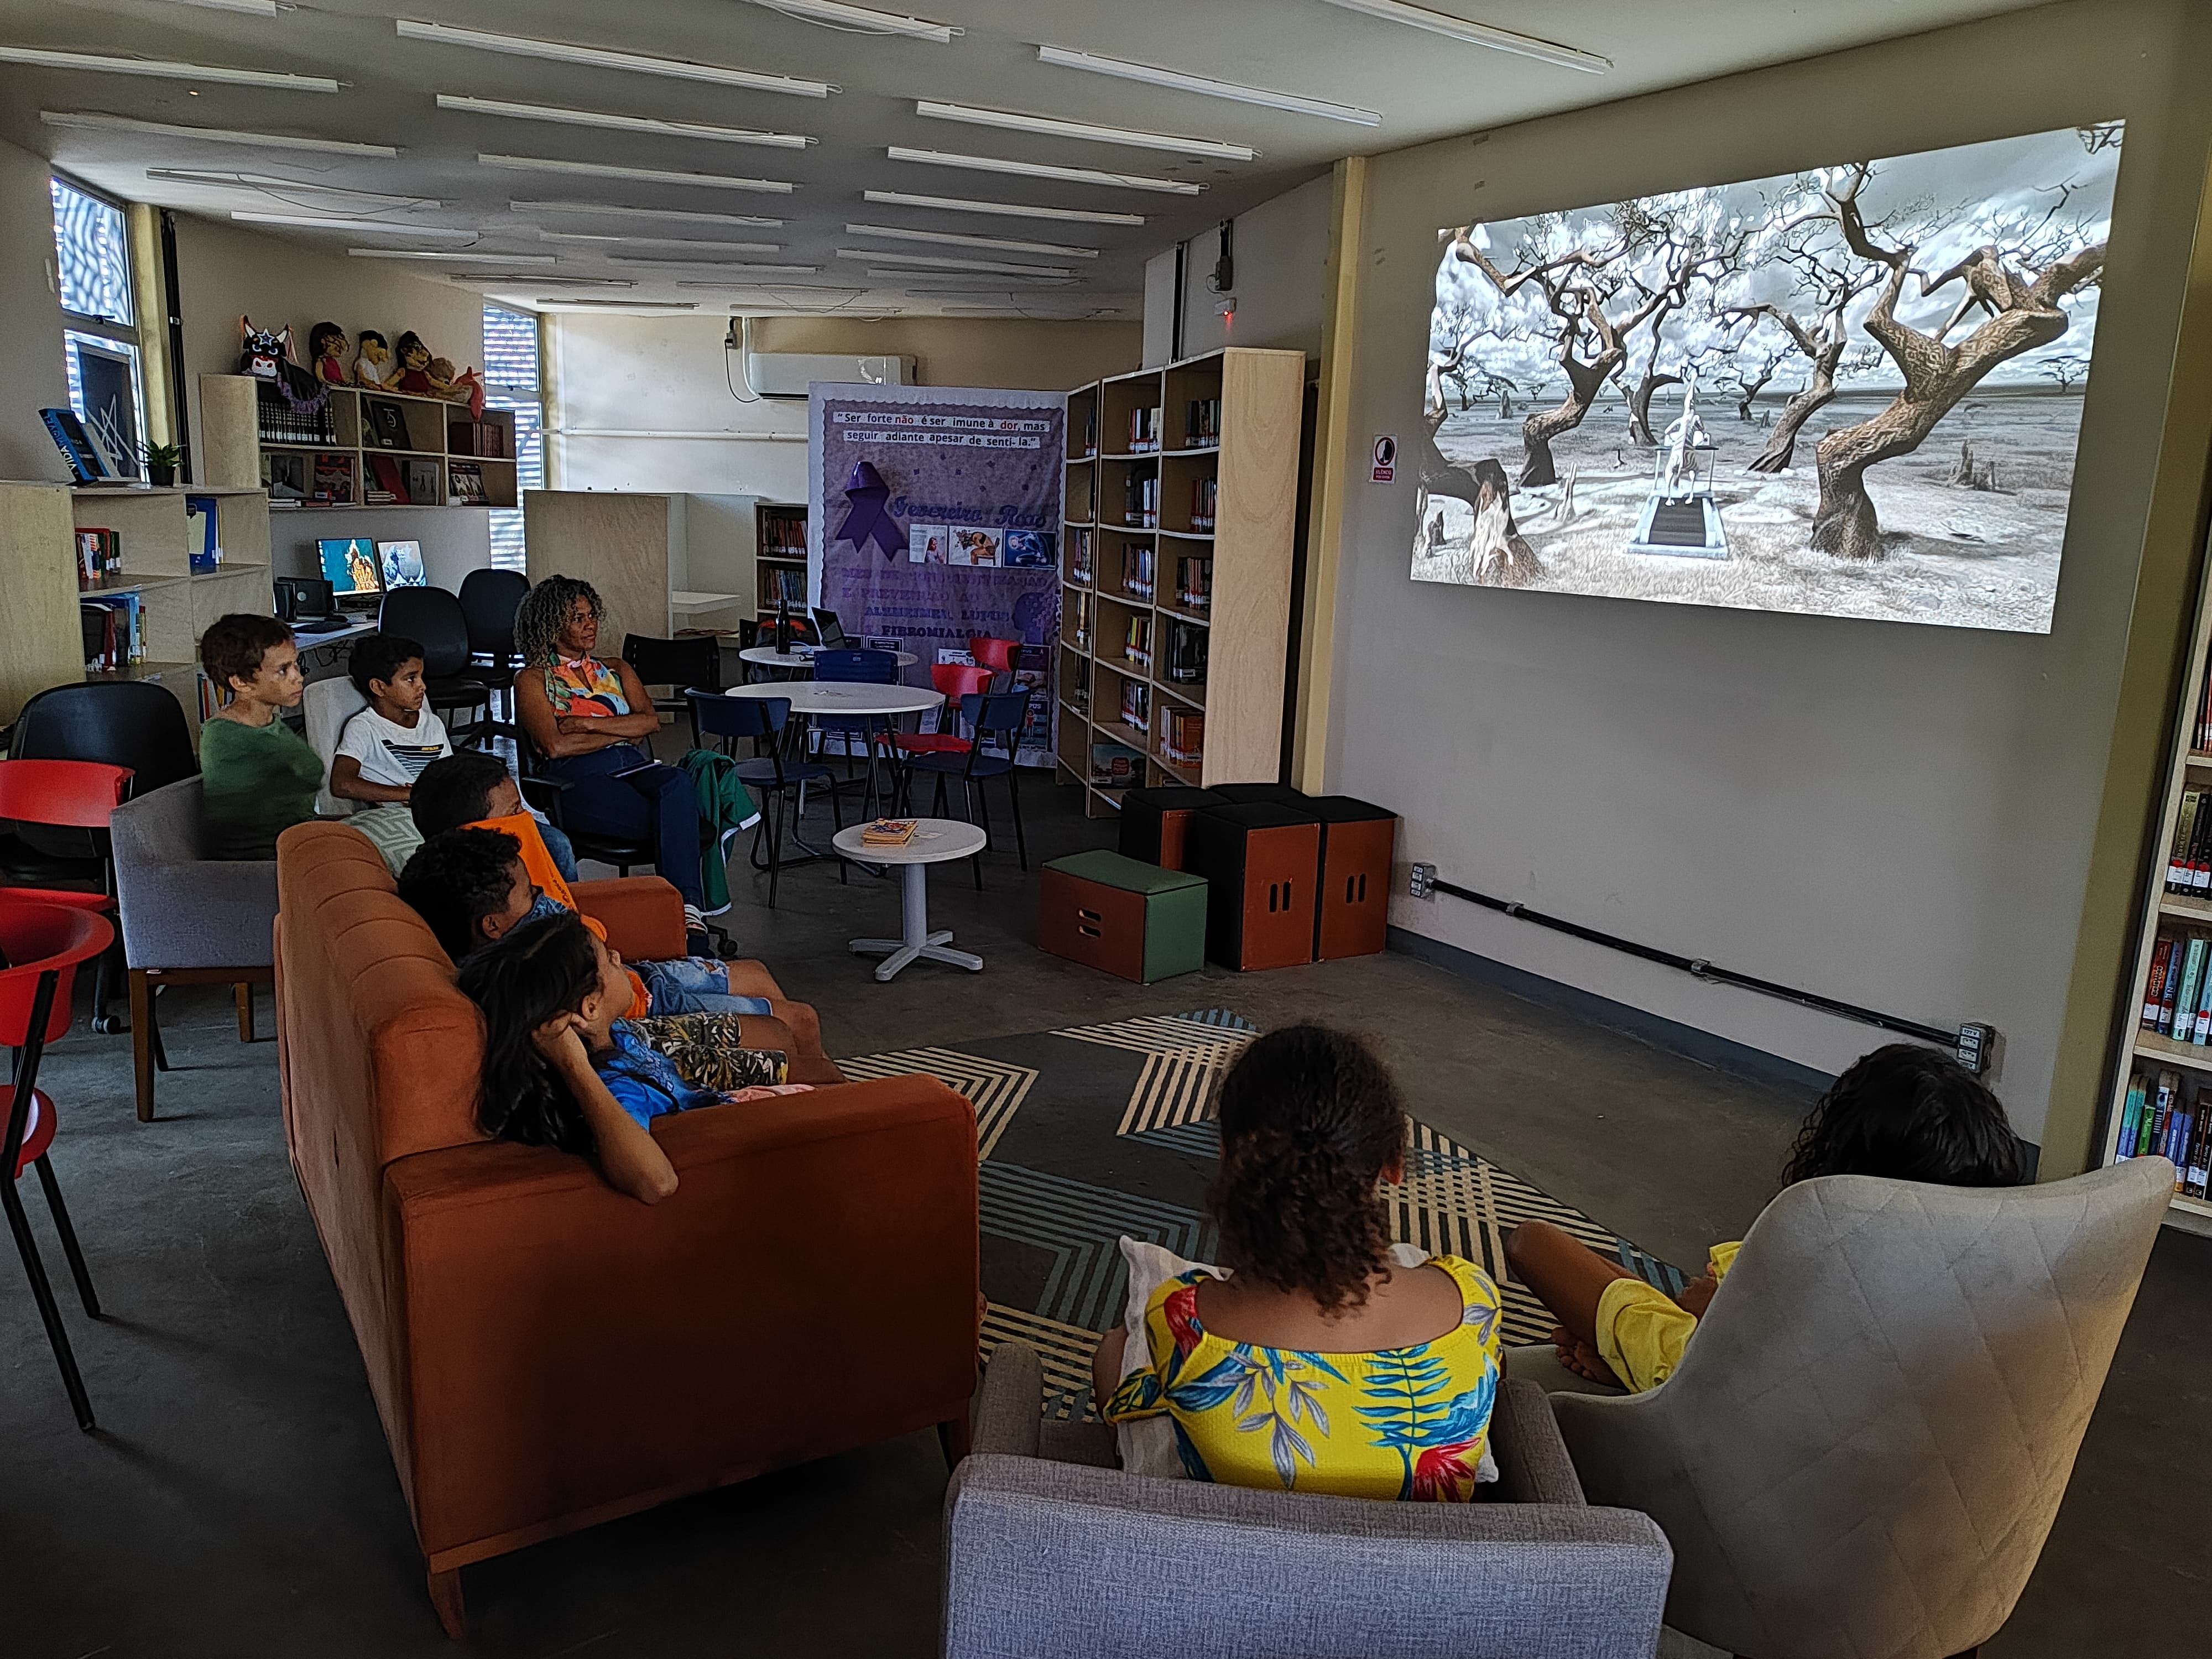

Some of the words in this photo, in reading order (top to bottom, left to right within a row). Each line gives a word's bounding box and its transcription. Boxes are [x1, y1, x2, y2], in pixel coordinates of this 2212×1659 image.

[867, 414, 893, 424] forte
[895, 415, 914, 425] não
[921, 415, 927, 425] é
[930, 418, 946, 426] ser
[953, 418, 985, 429] imune
[988, 419, 994, 429] à
[1000, 421, 1021, 432] dor,
[1024, 423, 1046, 431] mas
[847, 431, 879, 442] seguir
[885, 432, 925, 442] adiante
[929, 434, 964, 444] apesar
[968, 436, 982, 445] de
[881, 625, 993, 638] FIBROMIALGIA
